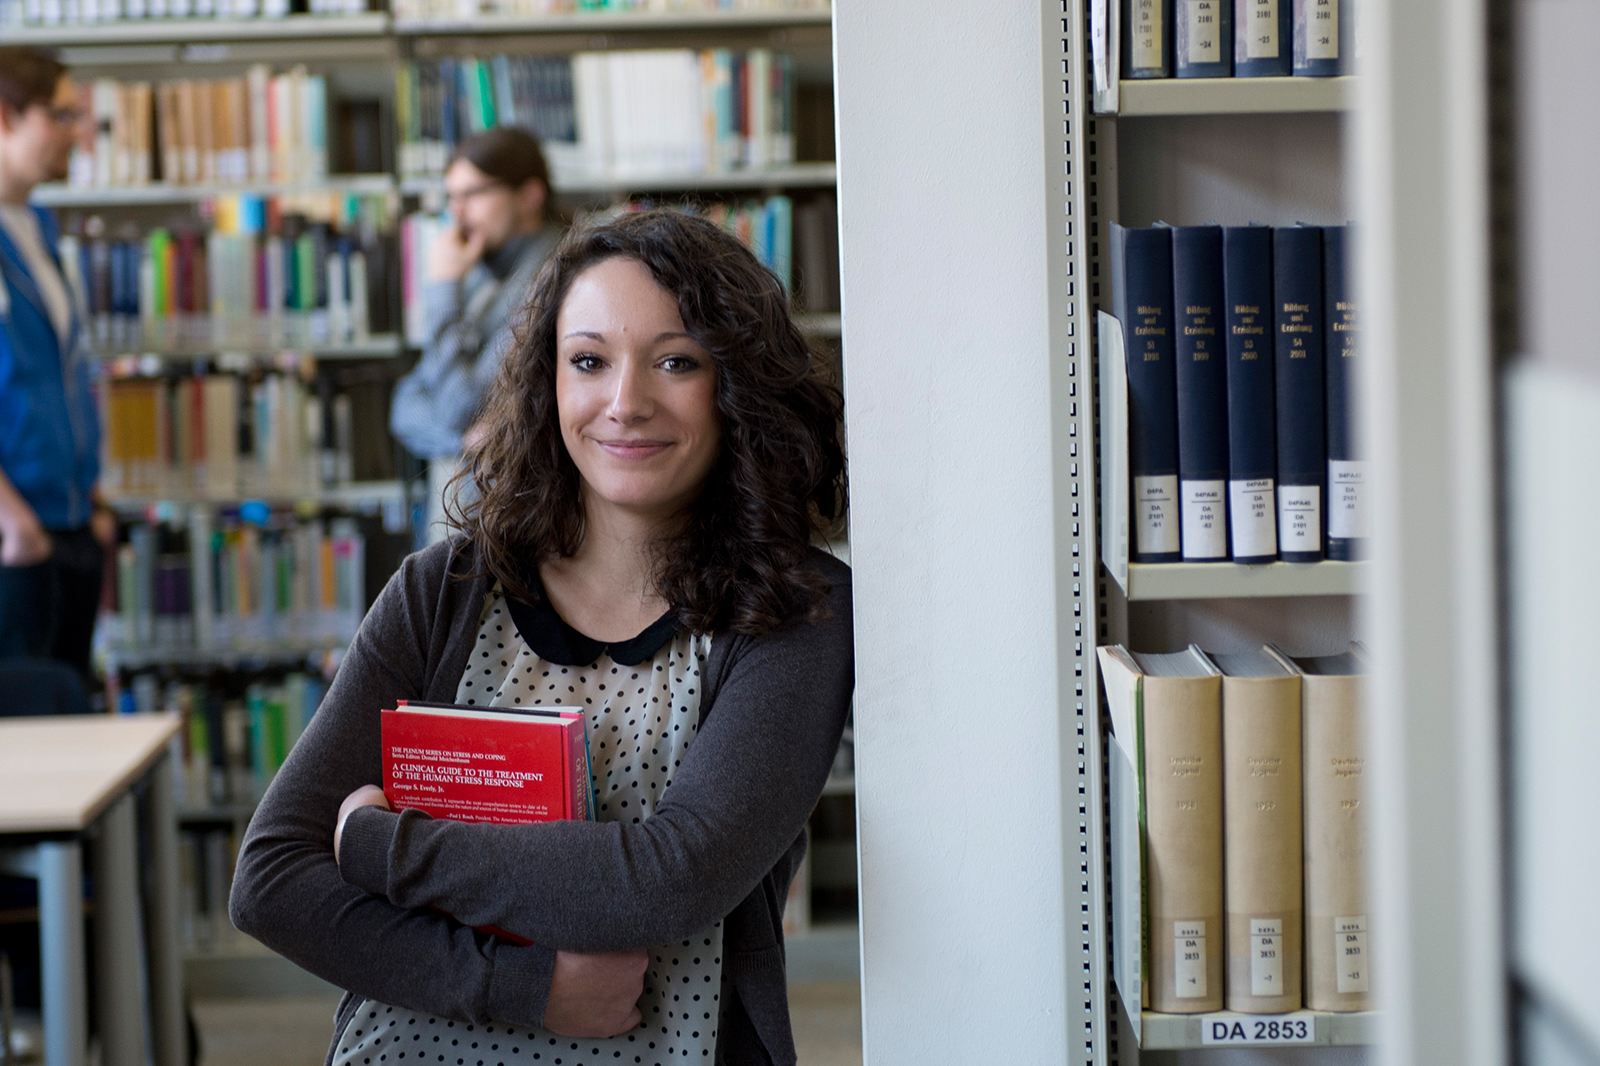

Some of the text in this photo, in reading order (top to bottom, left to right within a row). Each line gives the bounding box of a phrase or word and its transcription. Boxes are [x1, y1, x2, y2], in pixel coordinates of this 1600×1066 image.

[1256, 10, 1271, 18] 2101
[1316, 11, 1331, 20] 2101
[1198, 15, 1213, 23] 2101
[1139, 25, 1152, 33] 2101
[1258, 36, 1270, 44] -25
[1137, 305, 1162, 315] Bildung
[1186, 305, 1211, 315] Bildung
[1235, 305, 1260, 315] Bildung
[1283, 303, 1310, 312] Bildung
[403, 747, 424, 755] PLENUM
[400, 763, 436, 773] CLINICAL
[437, 766, 462, 776] GUIDE
[464, 768, 476, 776] TO
[478, 769, 494, 778] THE
[495, 770, 544, 781] TREATMENT
[392, 771, 524, 788] OF THE HUMAN STRESS RESPONSE
[392, 782, 412, 791] George
[420, 784, 437, 793] Everly,
[1261, 950, 1276, 958] 2853
[1345, 947, 1361, 955] 2853
[1212, 1020, 1308, 1040] DA 2853
